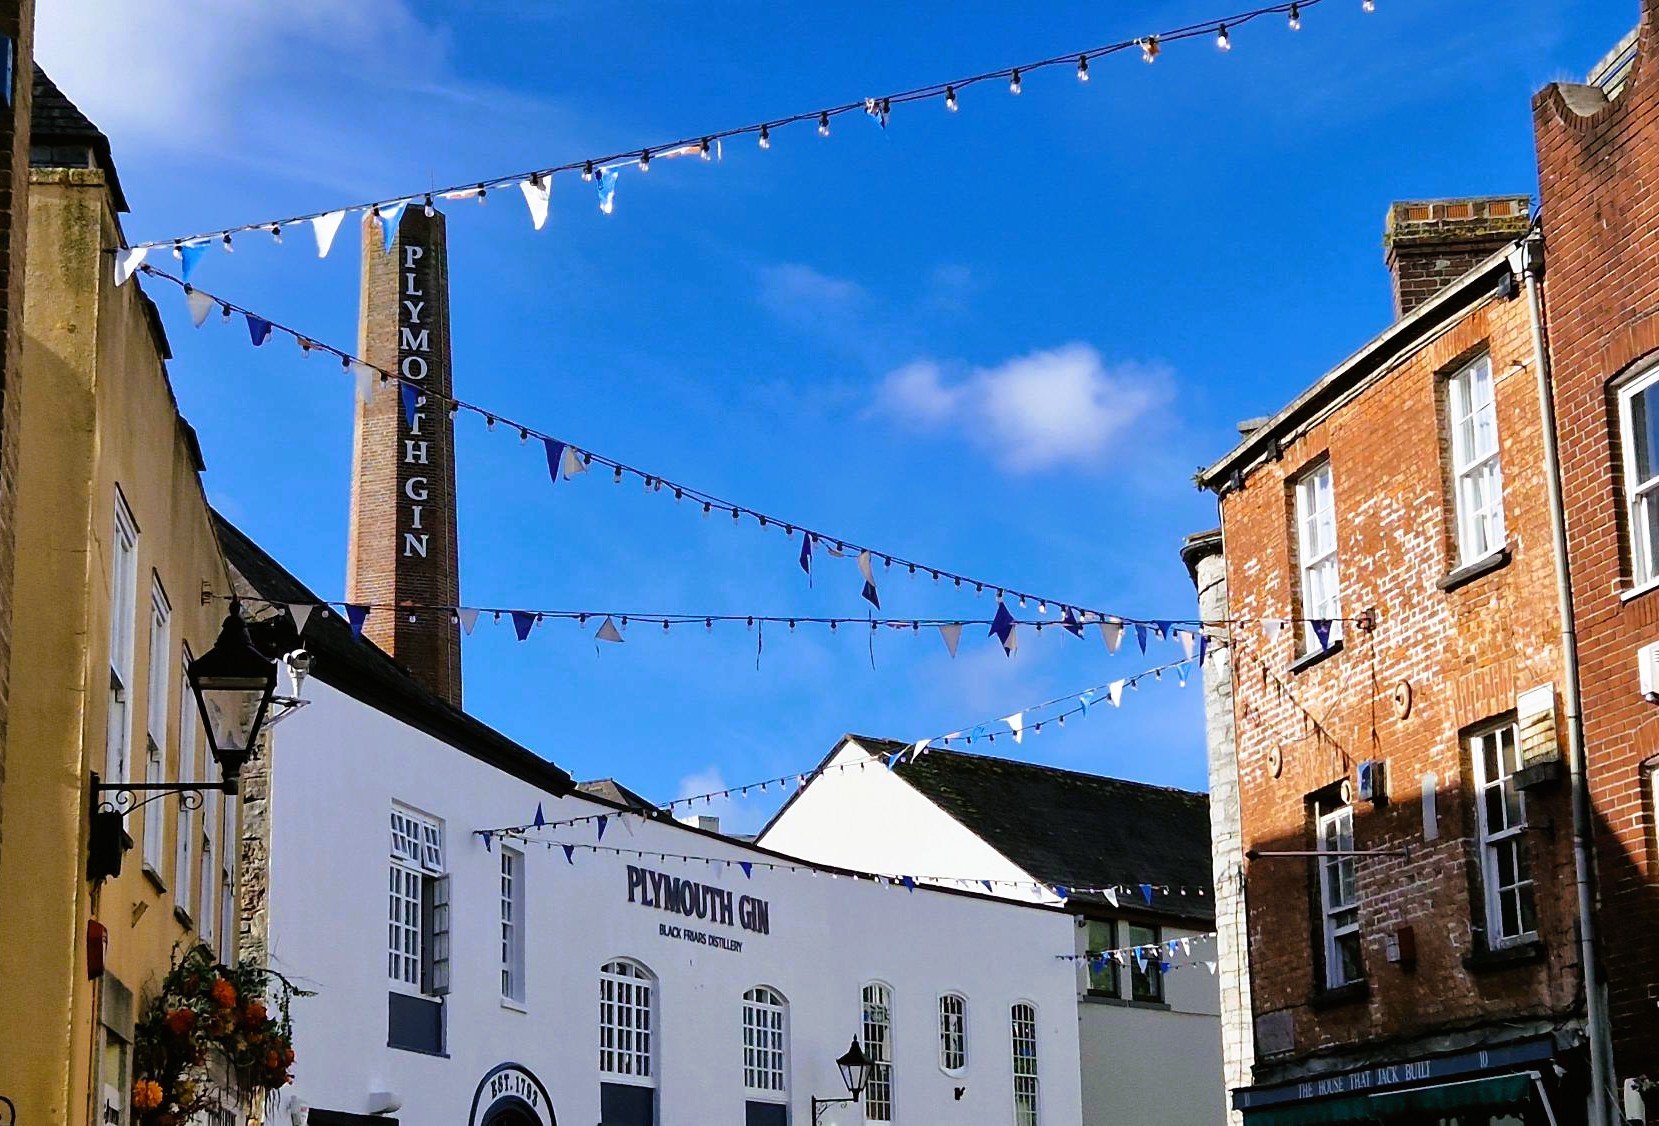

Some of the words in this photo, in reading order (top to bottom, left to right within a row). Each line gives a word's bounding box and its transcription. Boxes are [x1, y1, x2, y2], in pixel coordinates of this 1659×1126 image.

[400, 246, 429, 464] PLYMOTH
[404, 477, 430, 558] GIN
[627, 865, 734, 926] PLYMOUTH
[739, 894, 770, 935] GIN
[659, 923, 682, 939] BLACK
[683, 929, 707, 945] FRIARS
[708, 934, 743, 953] DISTILLERY
[491, 1074, 513, 1099] EST.
[516, 1076, 538, 1107] 1793
[1298, 1082, 1314, 1099] THE
[1318, 1076, 1345, 1095] HOUSE
[1349, 1071, 1371, 1091] THAT
[1377, 1065, 1400, 1086] JACK
[1404, 1060, 1431, 1081] BUILT
